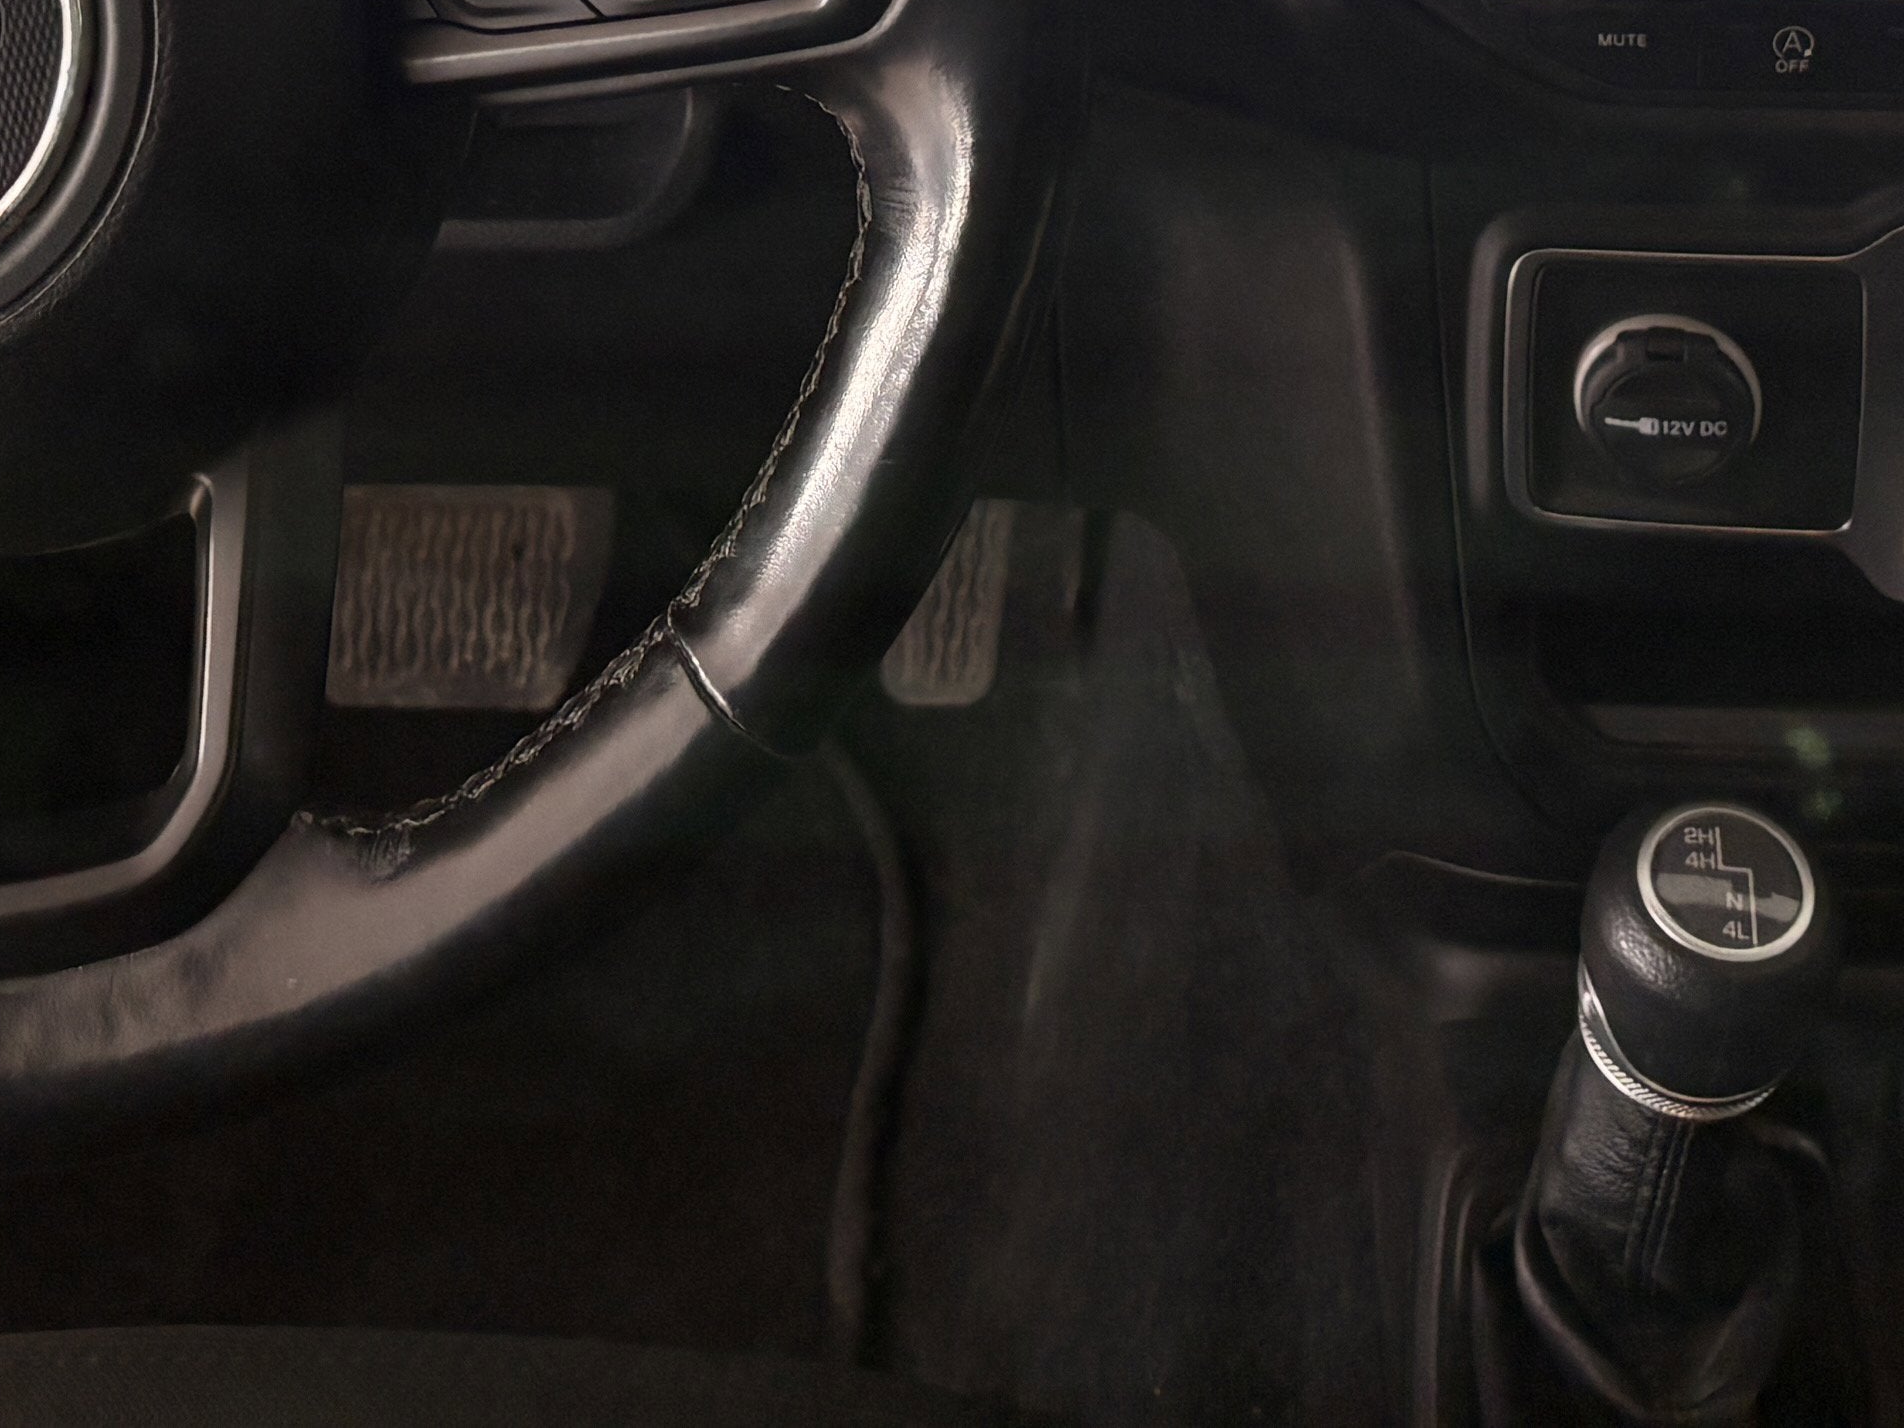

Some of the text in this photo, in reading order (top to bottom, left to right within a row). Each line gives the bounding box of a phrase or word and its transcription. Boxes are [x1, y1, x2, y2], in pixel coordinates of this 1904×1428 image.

[1597, 32, 1648, 48] MUTE
[1774, 59, 1810, 74] OFF
[1660, 418, 1728, 438] 12V DC
[1683, 826, 1714, 845] 2H
[1685, 851, 1715, 869] 4H
[1726, 892, 1743, 911] N
[1722, 920, 1750, 940] 4L
